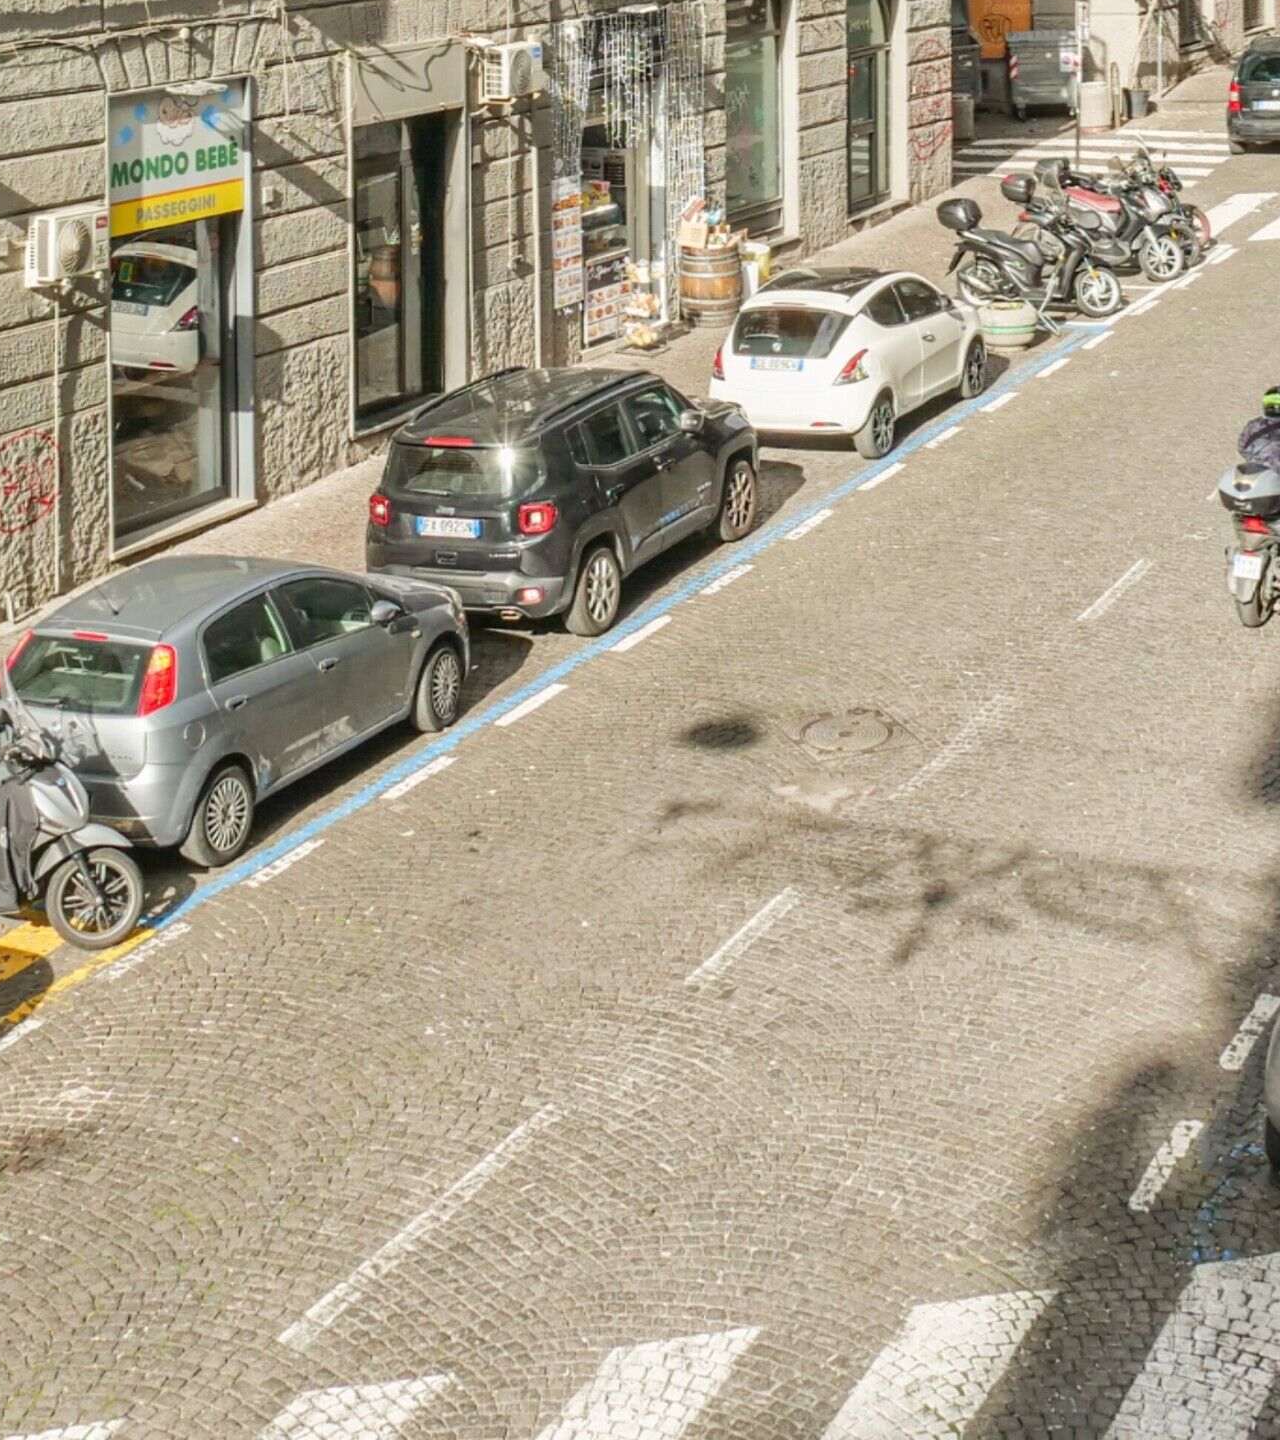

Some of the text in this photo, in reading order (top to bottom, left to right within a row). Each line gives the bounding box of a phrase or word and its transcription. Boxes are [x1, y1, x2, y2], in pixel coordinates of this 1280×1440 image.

[111, 136, 239, 188] MONDO BEBÈ
[135, 194, 217, 224] PASSEGGINI
